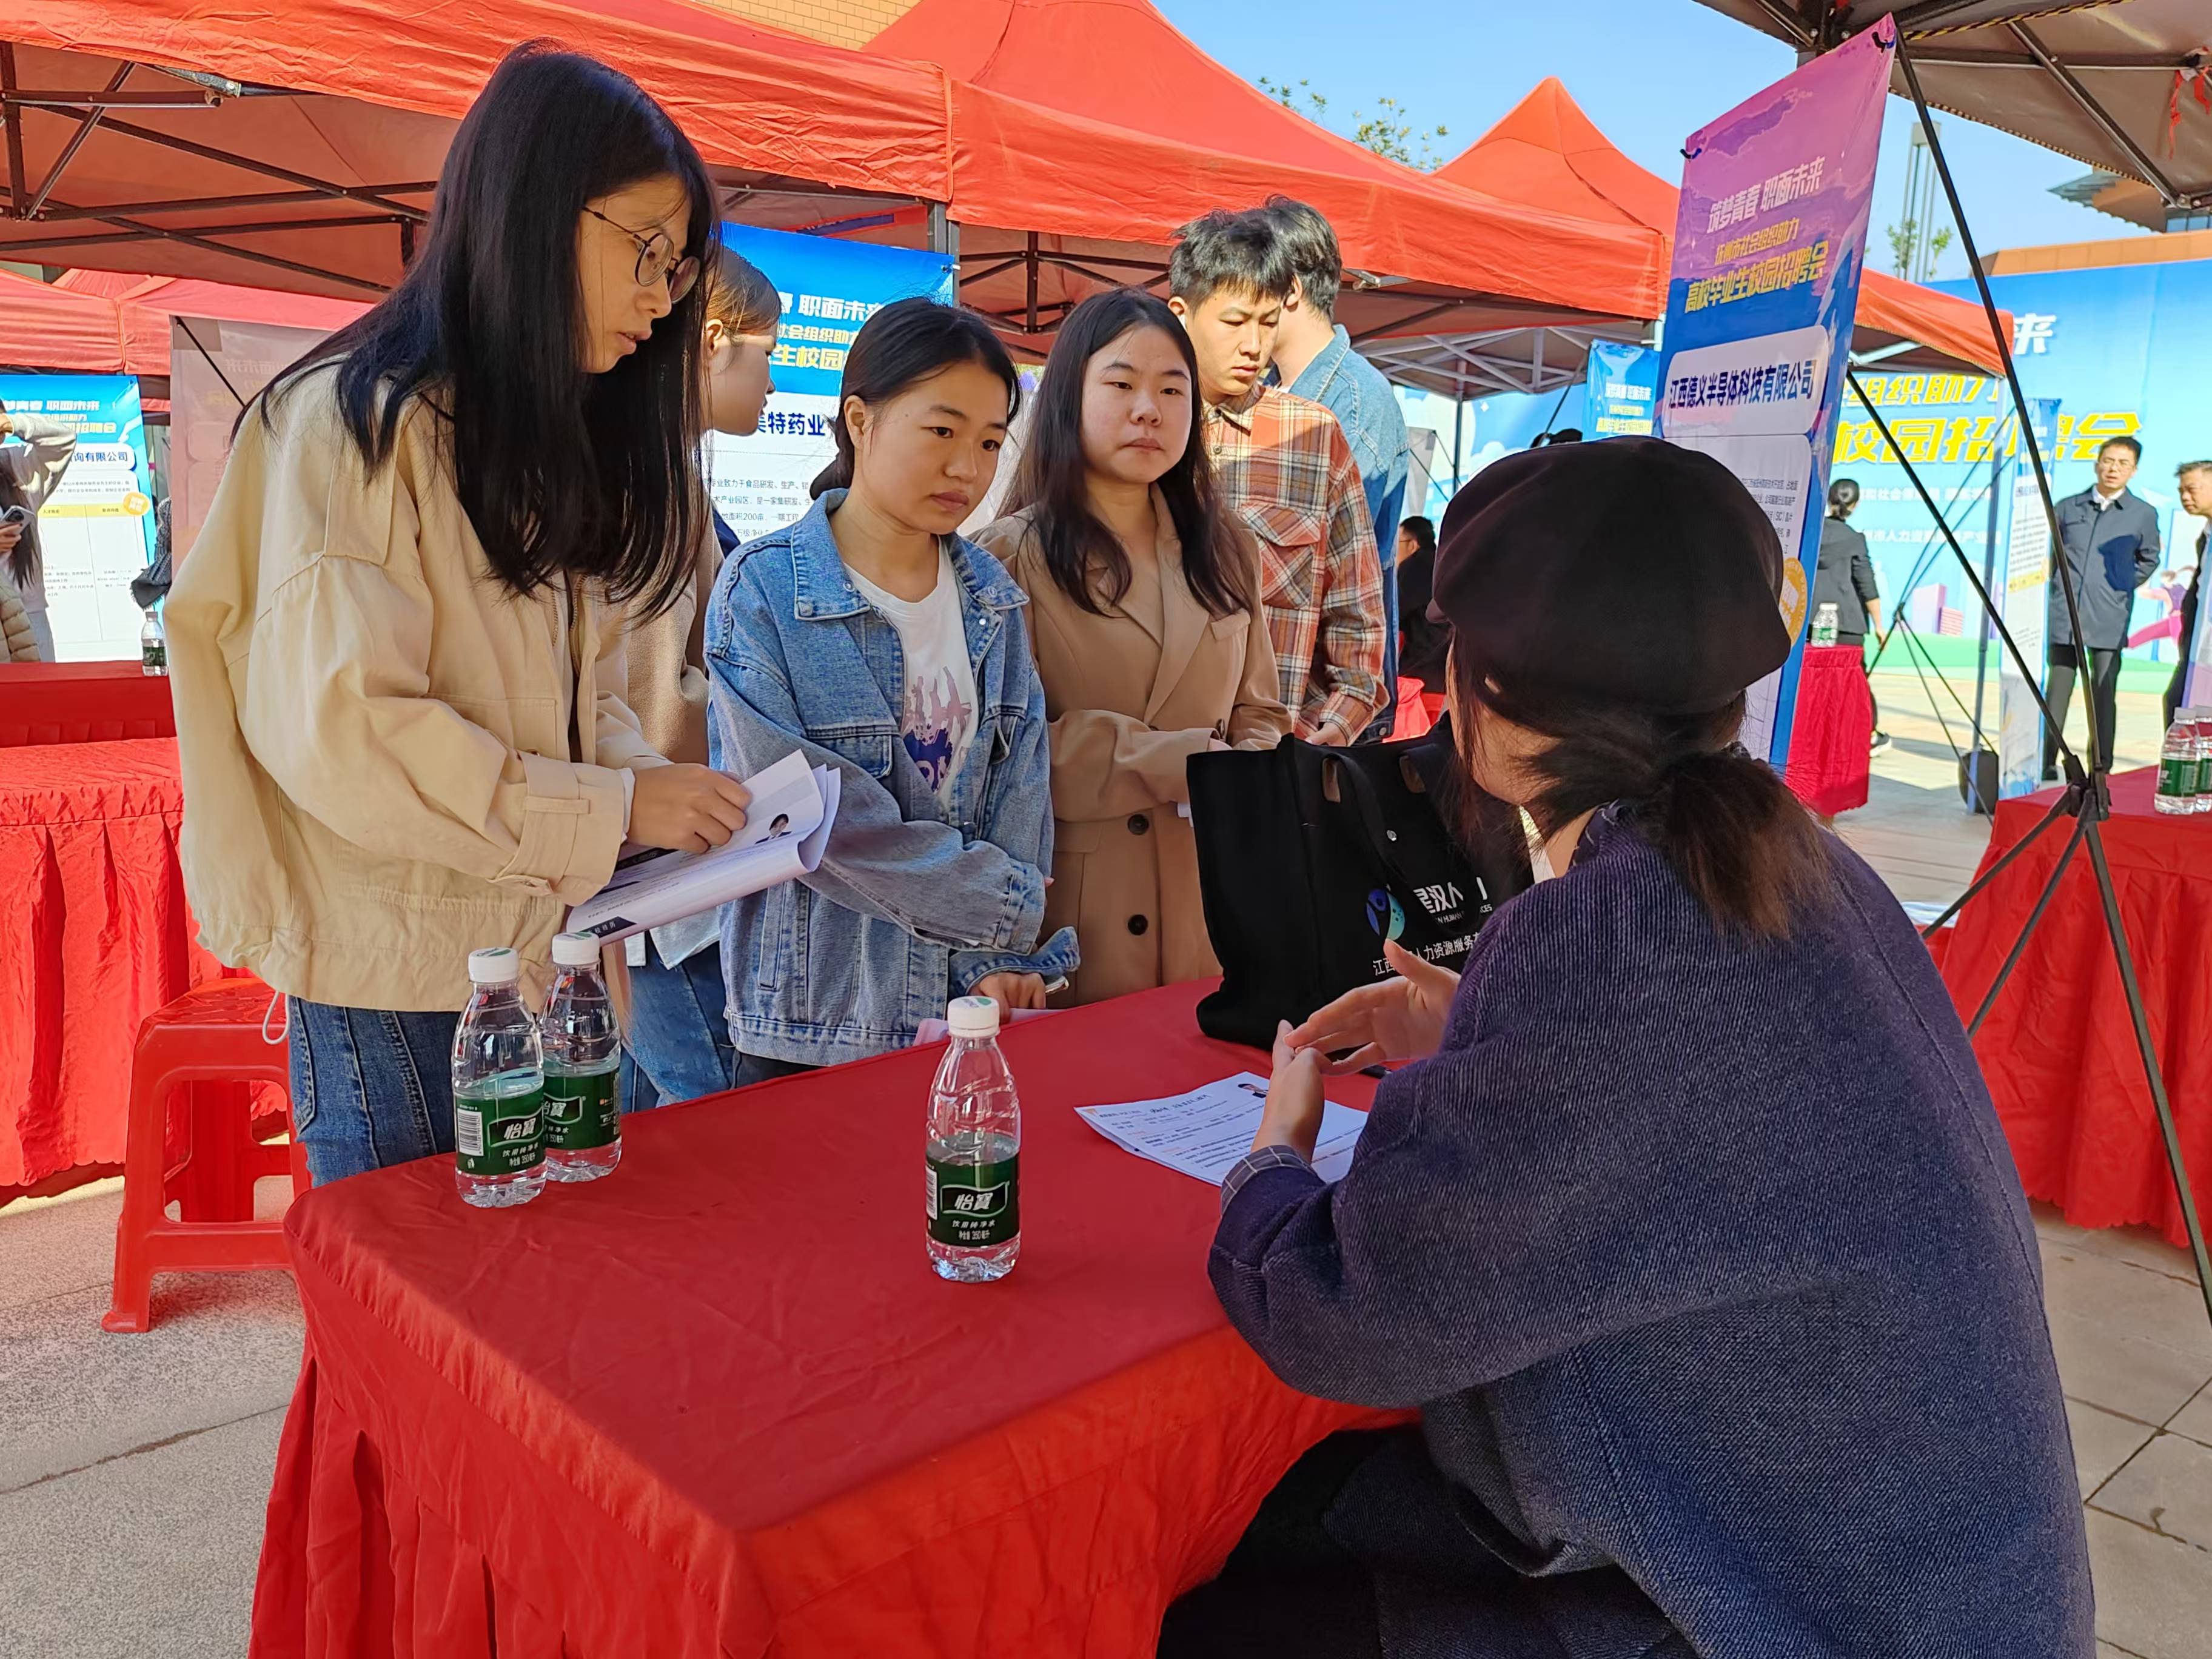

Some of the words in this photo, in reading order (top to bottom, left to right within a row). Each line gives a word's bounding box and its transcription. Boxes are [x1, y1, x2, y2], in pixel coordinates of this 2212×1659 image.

[1706, 183, 1761, 233] 筑梦青春
[1760, 156, 1825, 212] 职面未来
[1715, 217, 1800, 266] 抚州市社会组织助力
[1685, 241, 1829, 313] 高校毕业生校园招聘会
[1668, 359, 1818, 409] 江西德义半导体科技有限公司
[503, 1118, 536, 1140] 怡寶
[954, 1193, 993, 1211] 怡寶
